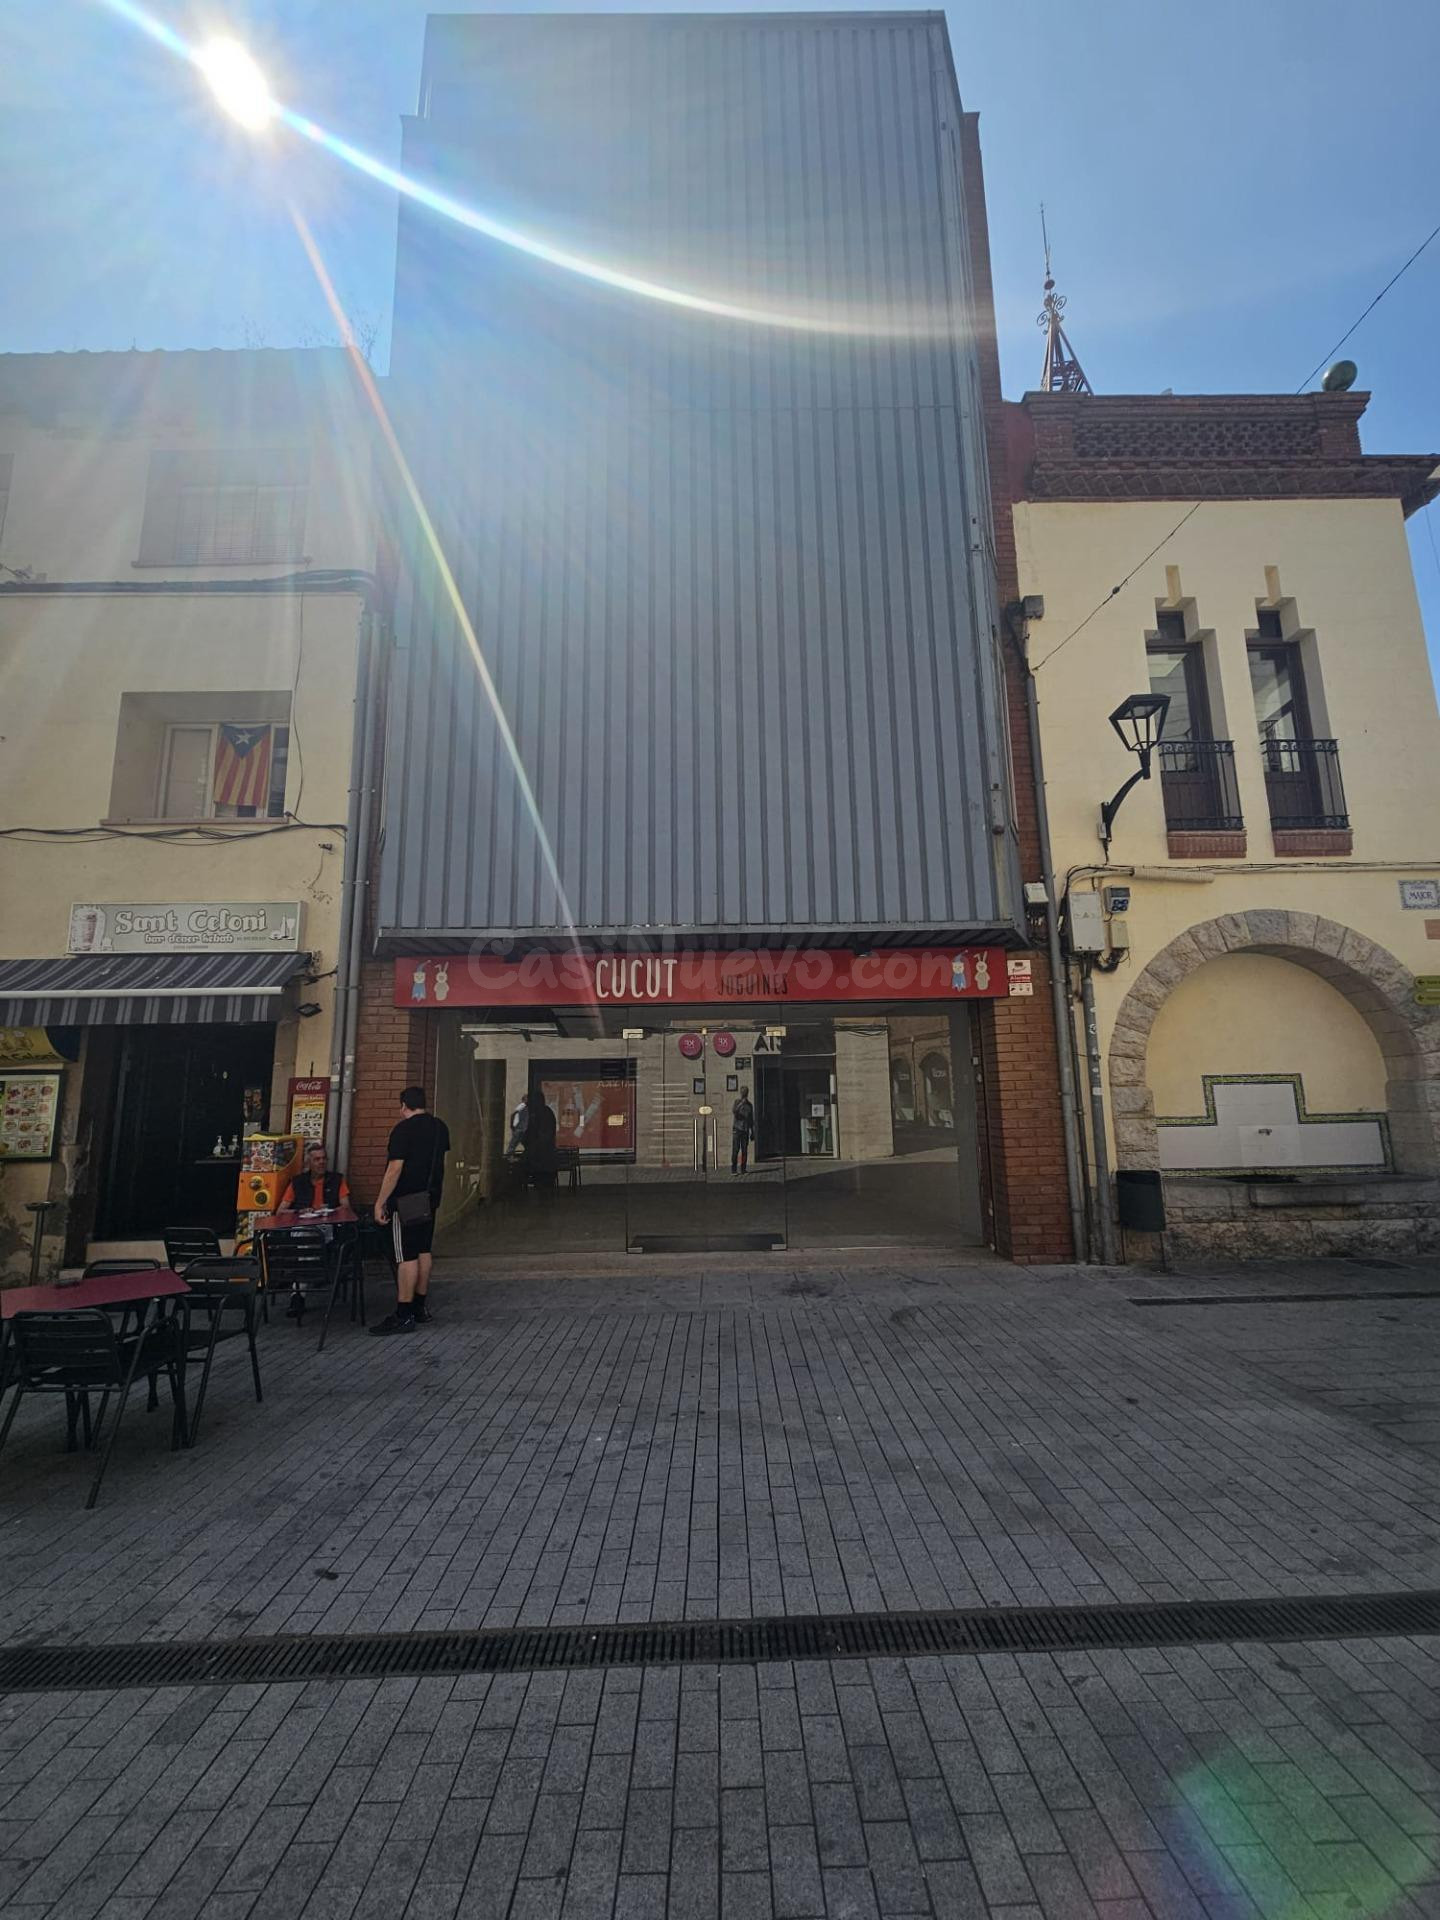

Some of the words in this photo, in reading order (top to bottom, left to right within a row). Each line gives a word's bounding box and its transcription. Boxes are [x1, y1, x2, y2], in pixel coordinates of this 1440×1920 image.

[114, 909, 179, 934] Sant
[188, 908, 268, 934] Celoni
[596, 958, 678, 998] CUCUT
[718, 973, 789, 995] JOGUINES
